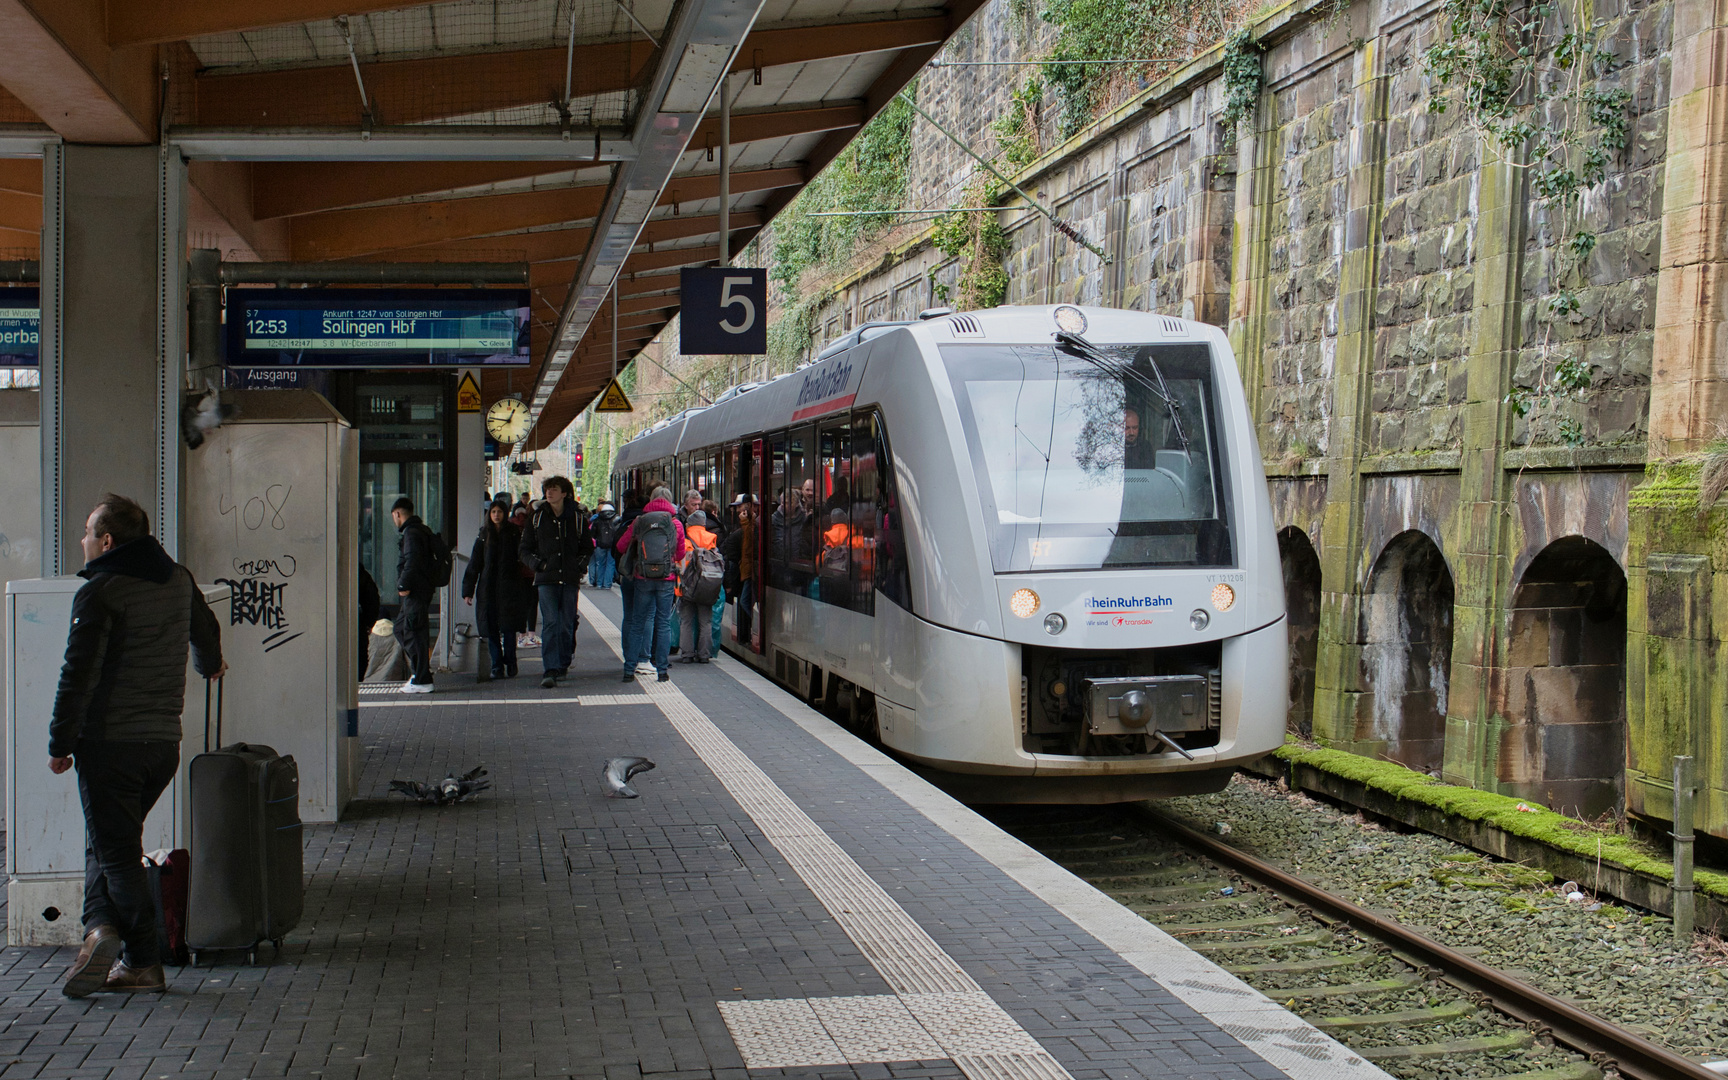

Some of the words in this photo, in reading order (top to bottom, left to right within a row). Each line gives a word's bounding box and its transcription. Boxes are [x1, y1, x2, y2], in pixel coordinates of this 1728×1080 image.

[718, 276, 756, 335] 5
[246, 309, 252, 317] S
[254, 309, 259, 317] 7
[323, 310, 354, 318] Ankunft
[357, 310, 377, 318] 12:47
[395, 310, 428, 320] Solingen
[429, 310, 443, 318] Hbf
[246, 319, 287, 334] 12:53
[322, 319, 386, 338] Solingen
[390, 319, 416, 334] Hbf
[247, 369, 297, 382] Ausgang
[219, 483, 293, 548] 408
[1032, 541, 1053, 557] S7
[1084, 594, 1173, 608] RheinRuhrBahn
[1124, 618, 1153, 626] transdev
